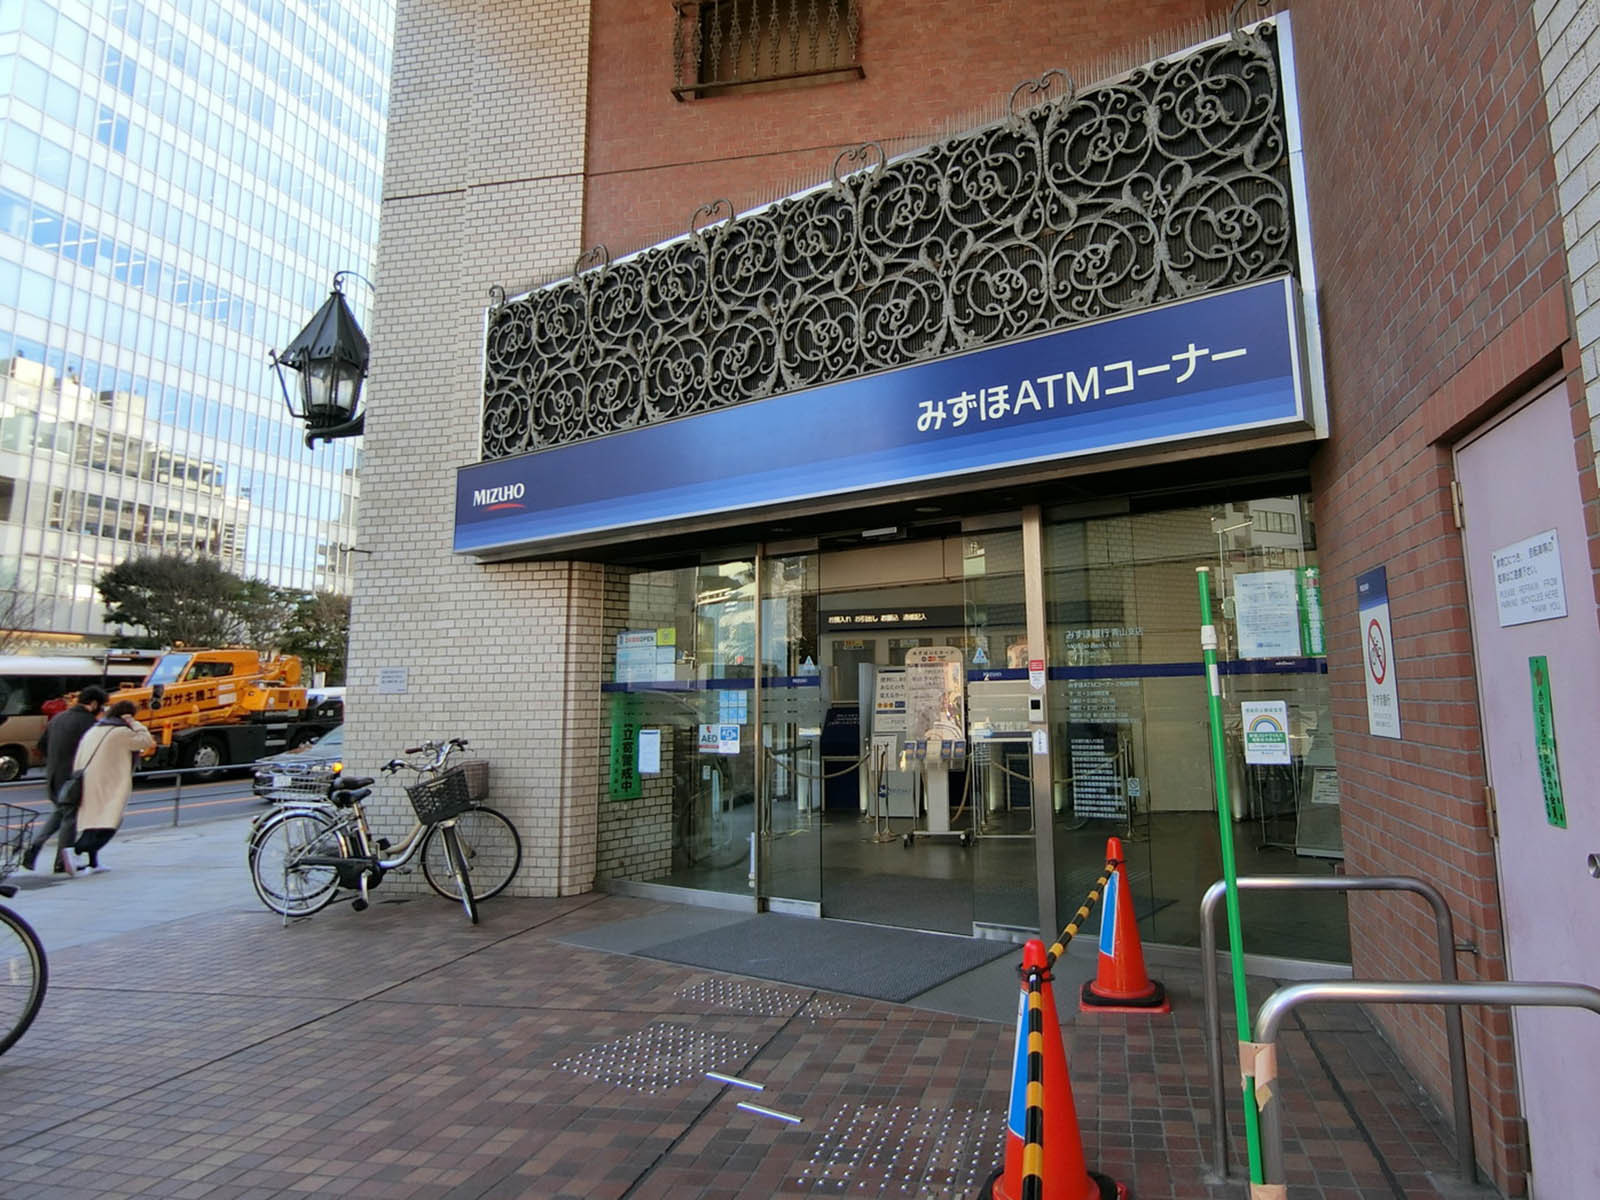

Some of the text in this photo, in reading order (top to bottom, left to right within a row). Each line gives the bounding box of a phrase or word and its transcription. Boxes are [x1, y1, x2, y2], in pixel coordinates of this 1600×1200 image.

[916, 343, 1247, 432] みずほATMコーナー
[473, 482, 525, 507] MIZUHO
[139, 687, 217, 710] 有ガサキ機工
[701, 734, 718, 743] AED
